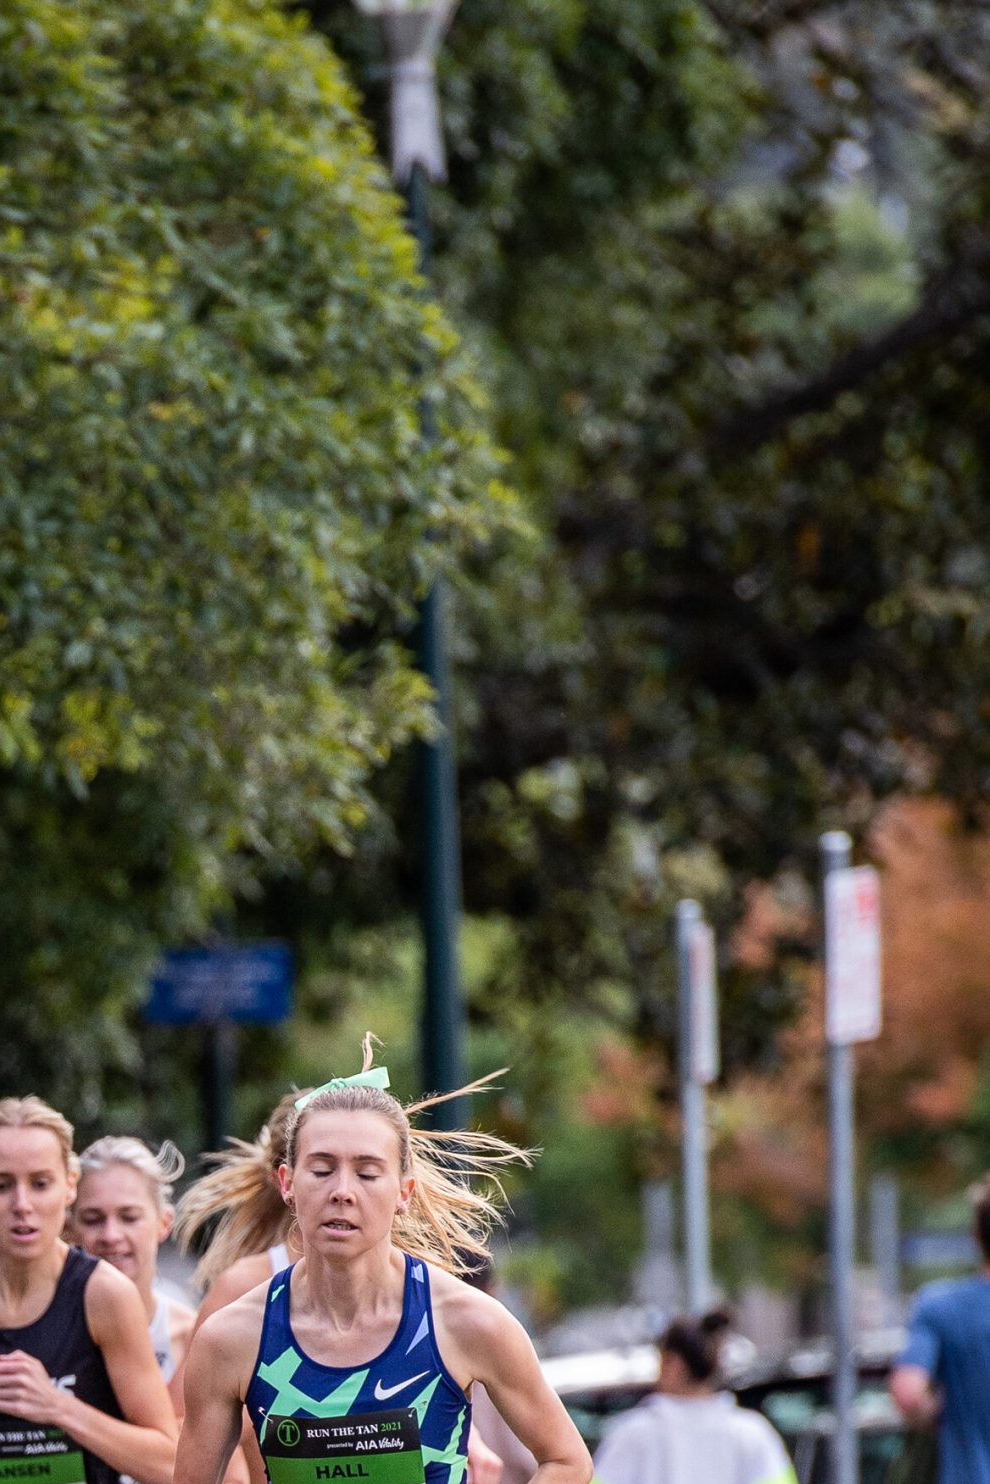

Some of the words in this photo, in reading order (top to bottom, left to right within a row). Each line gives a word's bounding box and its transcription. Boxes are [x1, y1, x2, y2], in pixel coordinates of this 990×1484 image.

[306, 1428, 330, 1438] RUN
[331, 1426, 355, 1437] THE
[355, 1423, 379, 1435] TAN
[380, 1421, 402, 1432] 2021
[355, 1440, 378, 1451] AIA
[378, 1436, 404, 1450] Vitality
[315, 1463, 370, 1479] HALL
